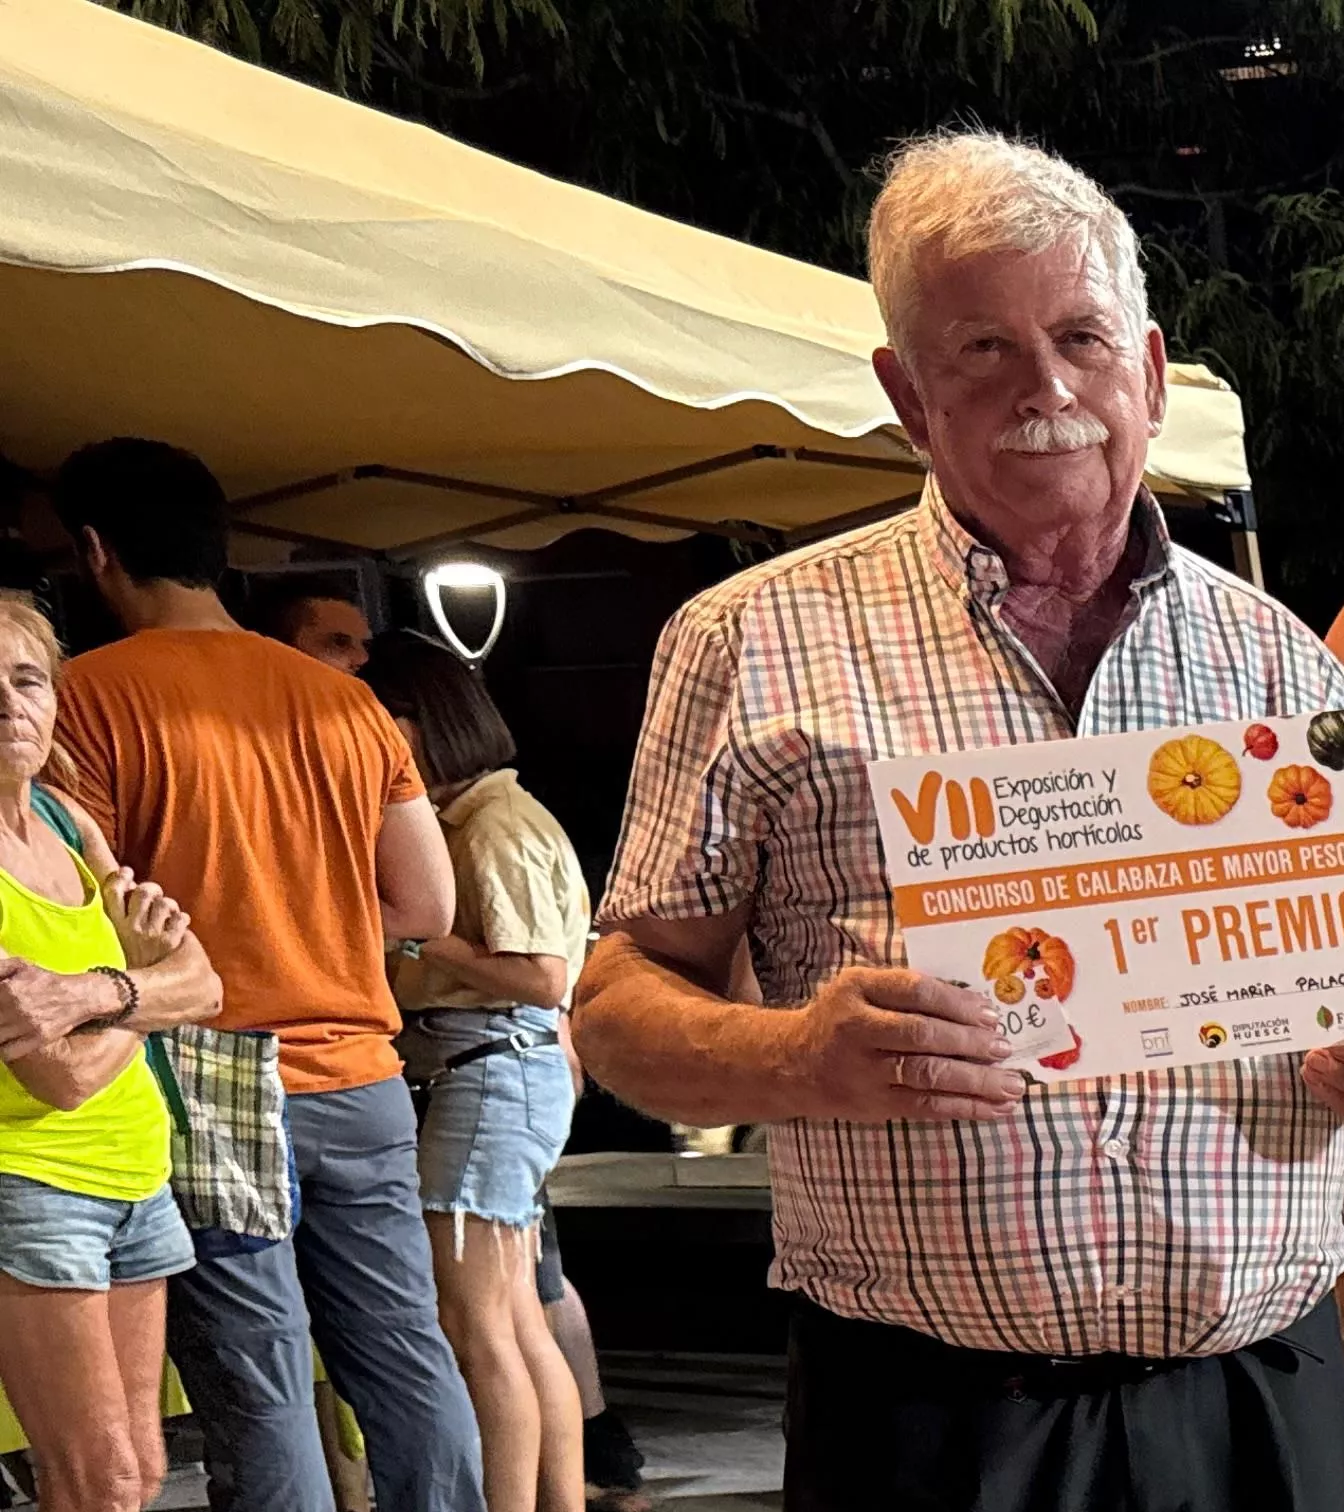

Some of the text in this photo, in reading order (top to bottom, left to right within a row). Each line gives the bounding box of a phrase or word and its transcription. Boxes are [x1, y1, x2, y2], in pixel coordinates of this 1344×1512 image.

[890, 770, 996, 846] VII
[993, 768, 1094, 802] Exposición
[1000, 793, 1123, 830] Degustación
[907, 823, 1143, 871] de productos hortícolas
[922, 881, 1035, 917] CONCURSO
[1042, 874, 1071, 901] DE
[1077, 860, 1182, 897] CALABAZA
[1189, 855, 1217, 883] DE
[1222, 848, 1293, 880] MAYOR
[1233, 1026, 1290, 1041] HUESCA
